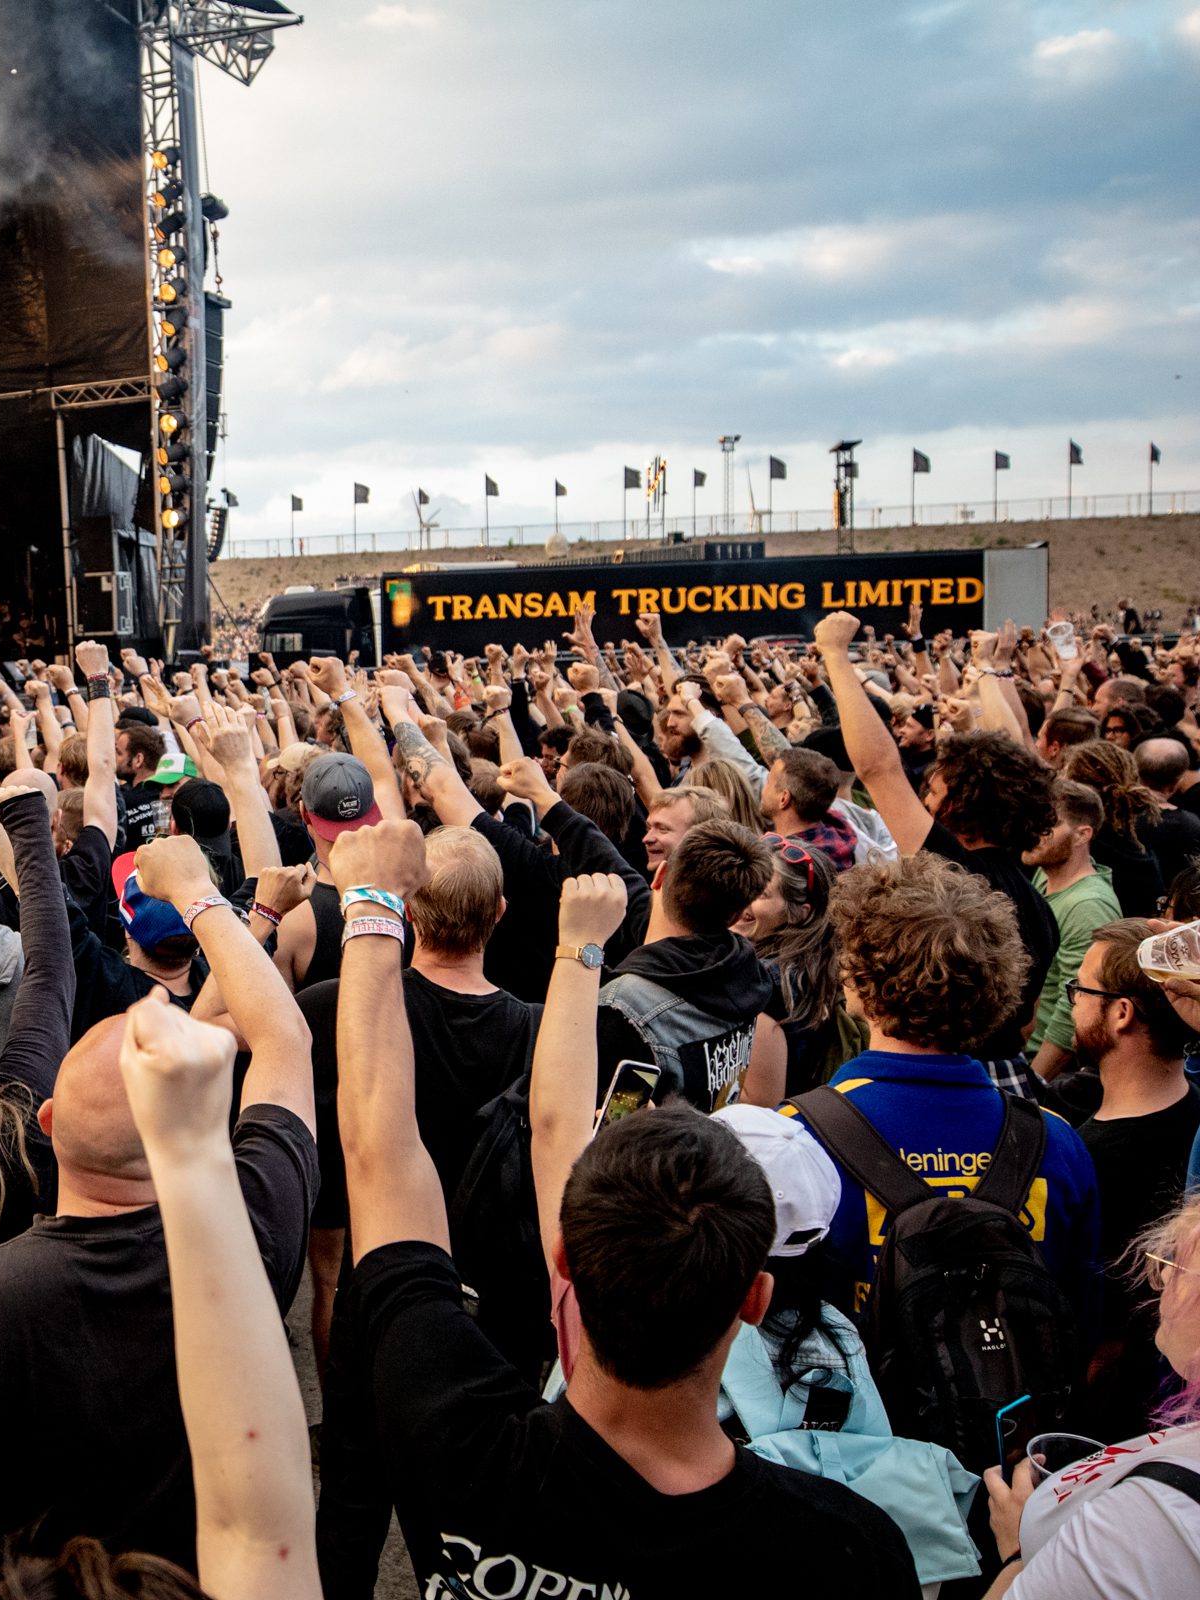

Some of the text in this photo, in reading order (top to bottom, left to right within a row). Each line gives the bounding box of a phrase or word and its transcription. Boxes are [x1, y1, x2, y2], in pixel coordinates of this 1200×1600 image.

[428, 576, 985, 621] TRANSAM TRUCKING LIMITED
